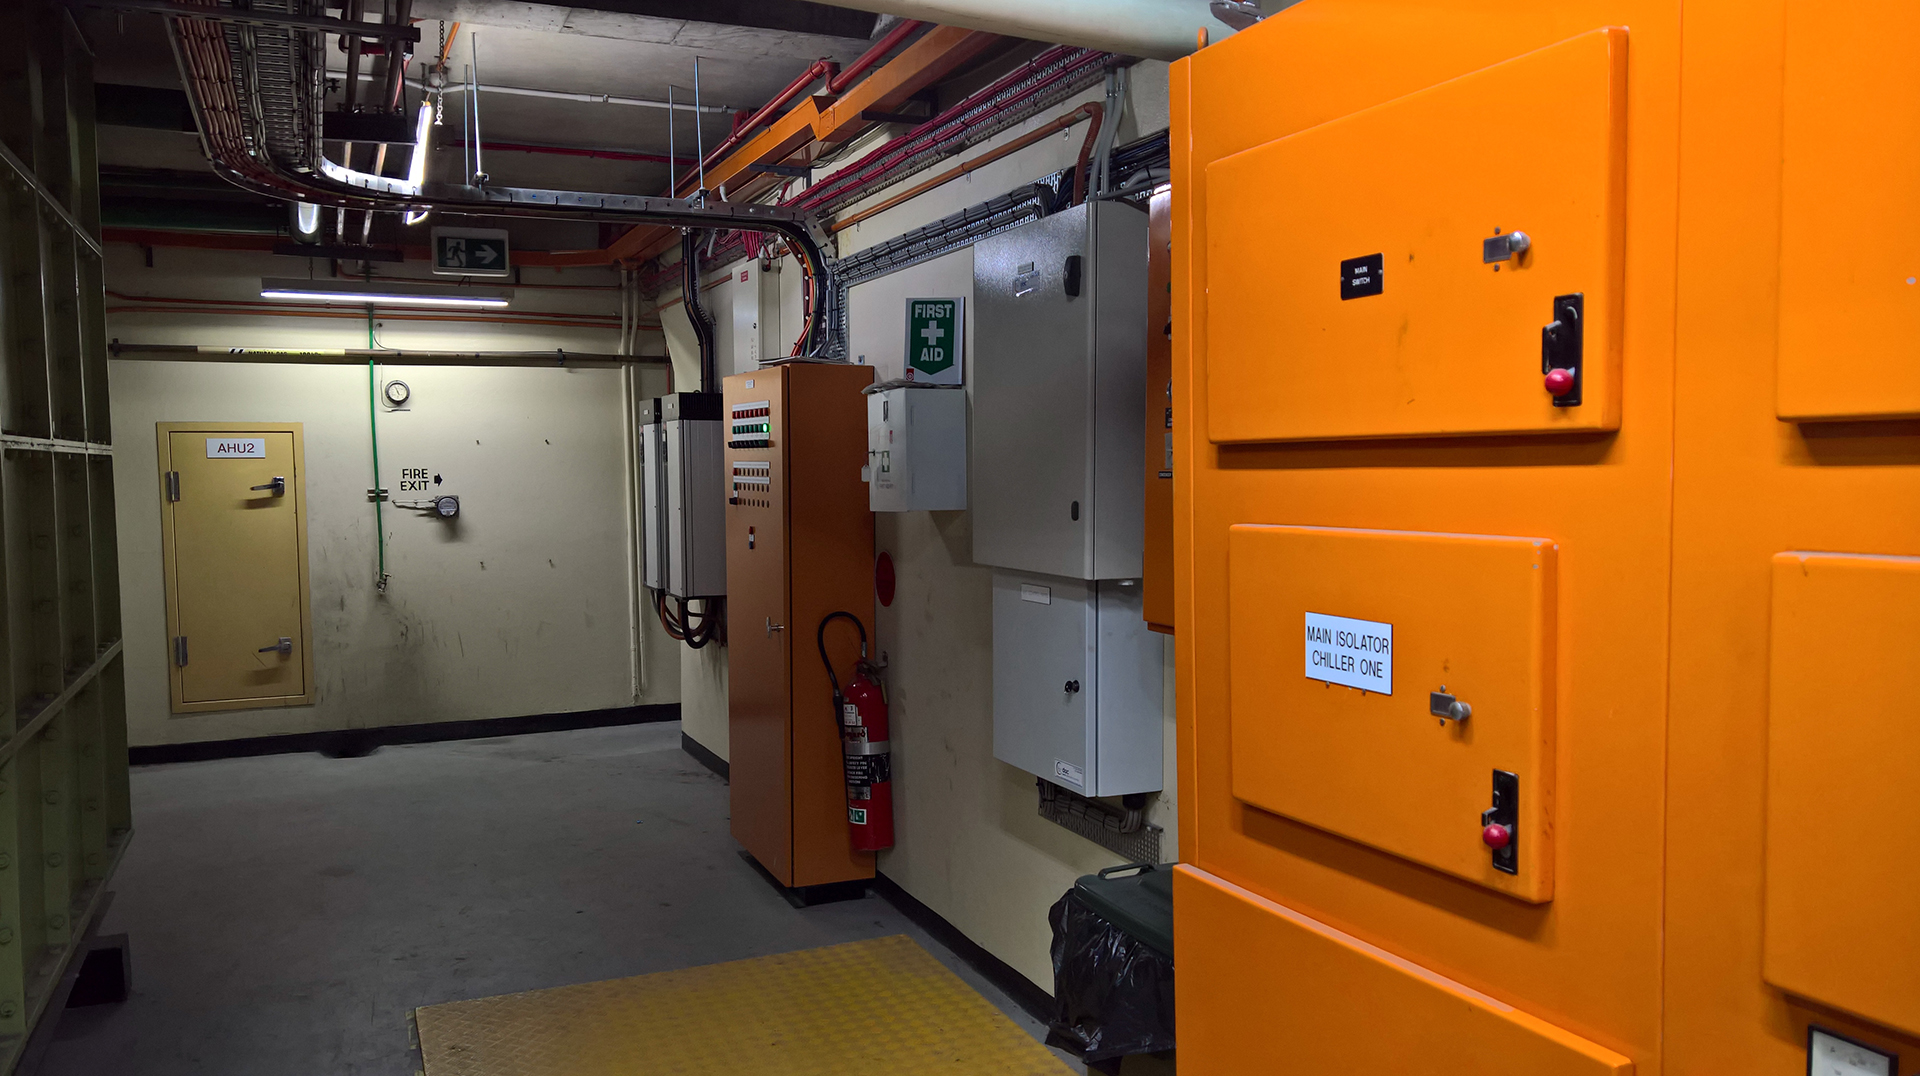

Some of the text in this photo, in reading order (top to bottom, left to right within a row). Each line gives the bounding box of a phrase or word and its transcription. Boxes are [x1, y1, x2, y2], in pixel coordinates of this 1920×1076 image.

[1354, 265, 1368, 274] MAIN
[1352, 276, 1371, 287] SWITCH
[914, 304, 953, 318] FIRST
[920, 347, 944, 362] AID
[217, 443, 255, 454] AHU2
[402, 468, 428, 479] FIRE
[400, 480, 429, 491] EXIT
[1307, 625, 1390, 655] MAIN ISOLATOR
[1312, 650, 1383, 679] CHILLER ONE
